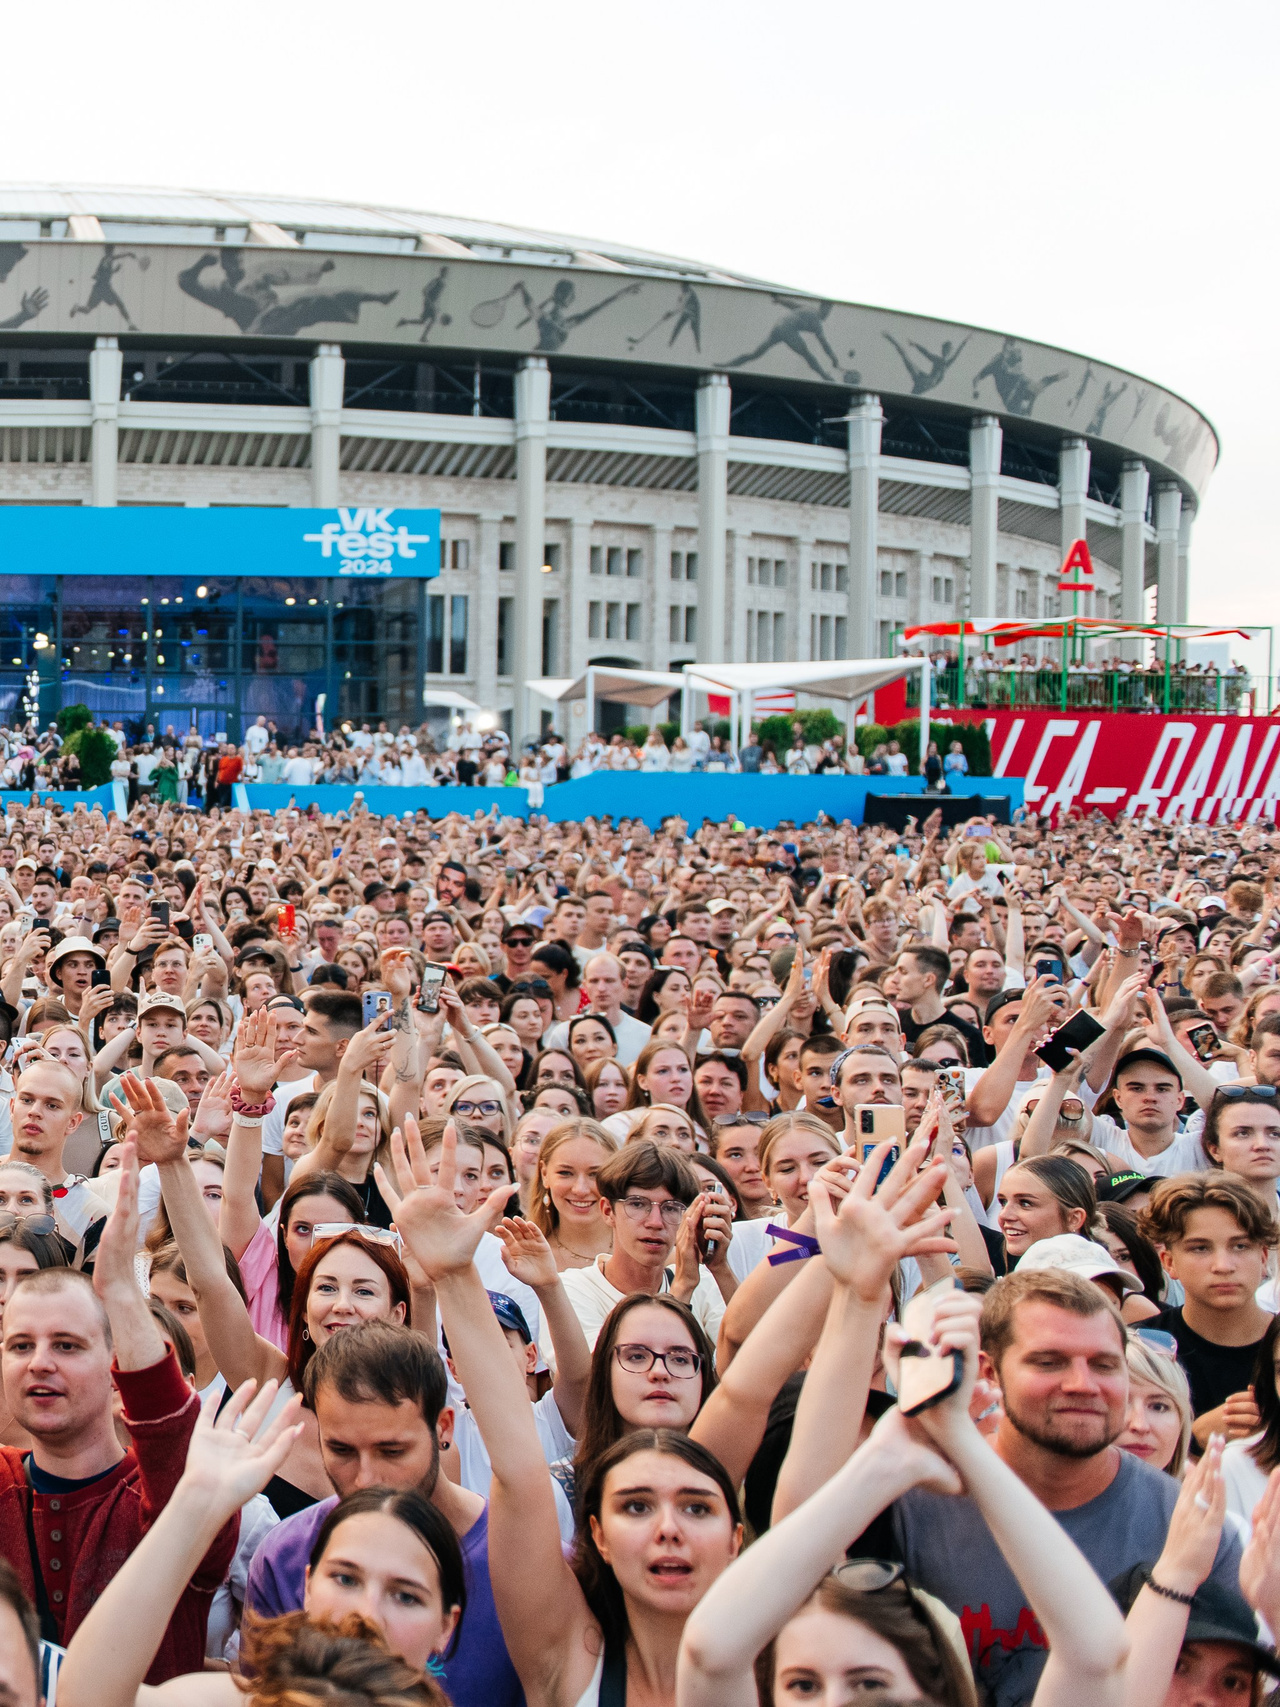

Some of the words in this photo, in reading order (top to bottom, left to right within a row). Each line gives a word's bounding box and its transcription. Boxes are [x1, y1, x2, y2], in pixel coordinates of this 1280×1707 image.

[337, 507, 396, 533] VK
[303, 523, 430, 559] fest
[339, 559, 393, 575] 2024
